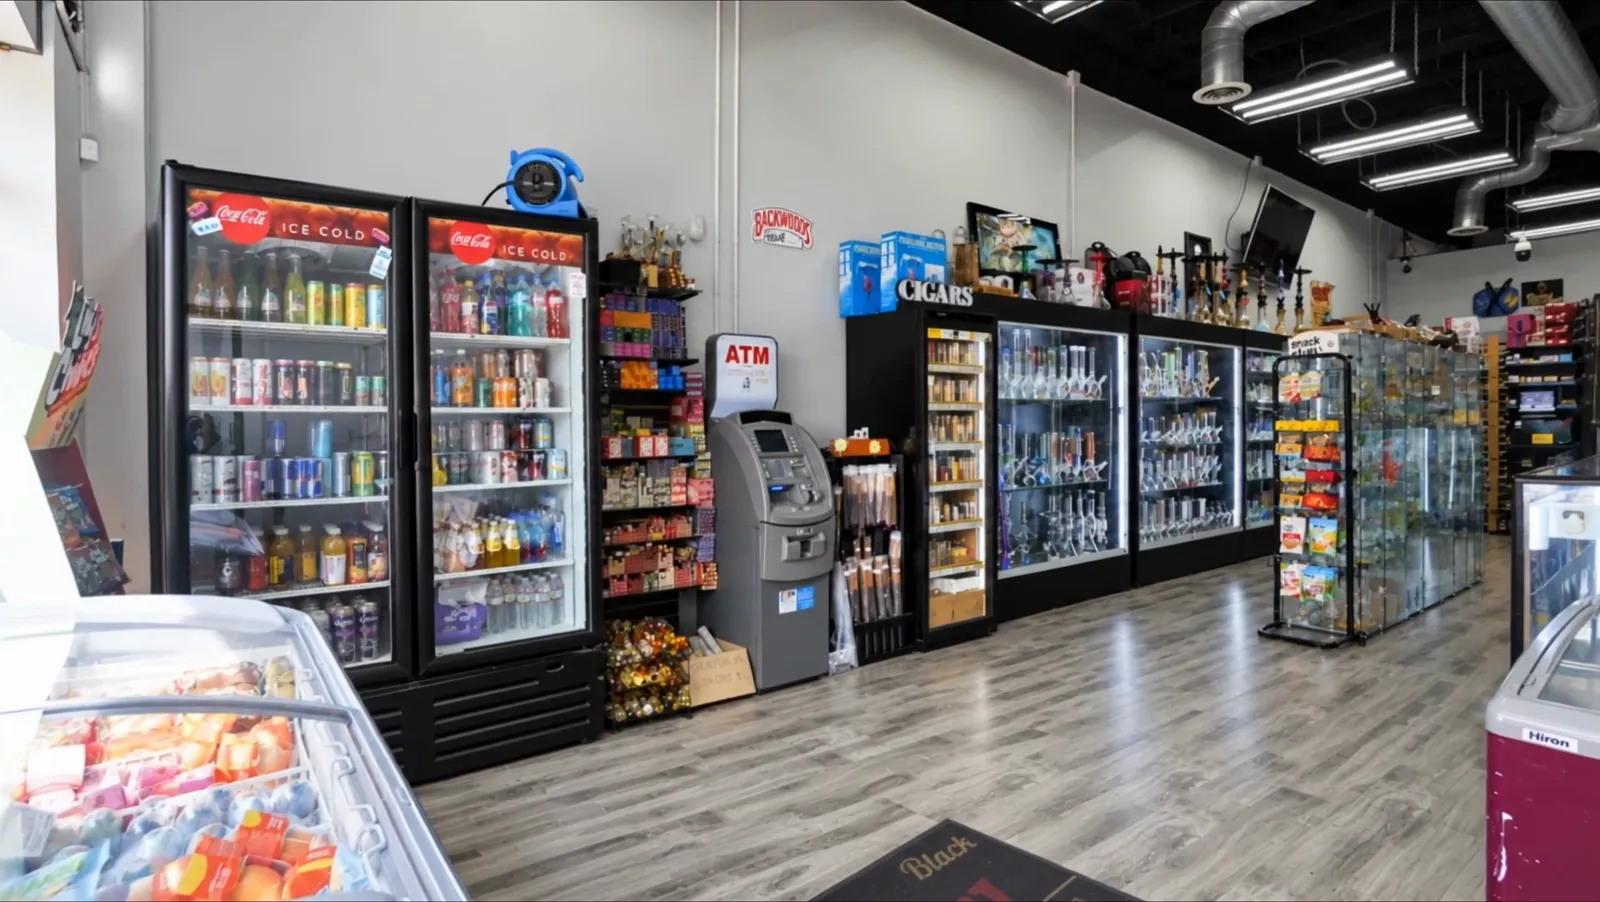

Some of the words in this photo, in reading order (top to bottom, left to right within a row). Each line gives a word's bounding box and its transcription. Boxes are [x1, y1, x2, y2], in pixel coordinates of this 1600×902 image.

[281, 223, 310, 236] ICE
[318, 226, 366, 241] COLD
[754, 209, 810, 245] BACKWOODS
[502, 245, 525, 257] ICE
[531, 248, 567, 262] COLD
[898, 279, 974, 307] CIGARS
[725, 344, 770, 365] ATM
[1528, 730, 1570, 748] Hiron
[899, 836, 978, 881] Black
